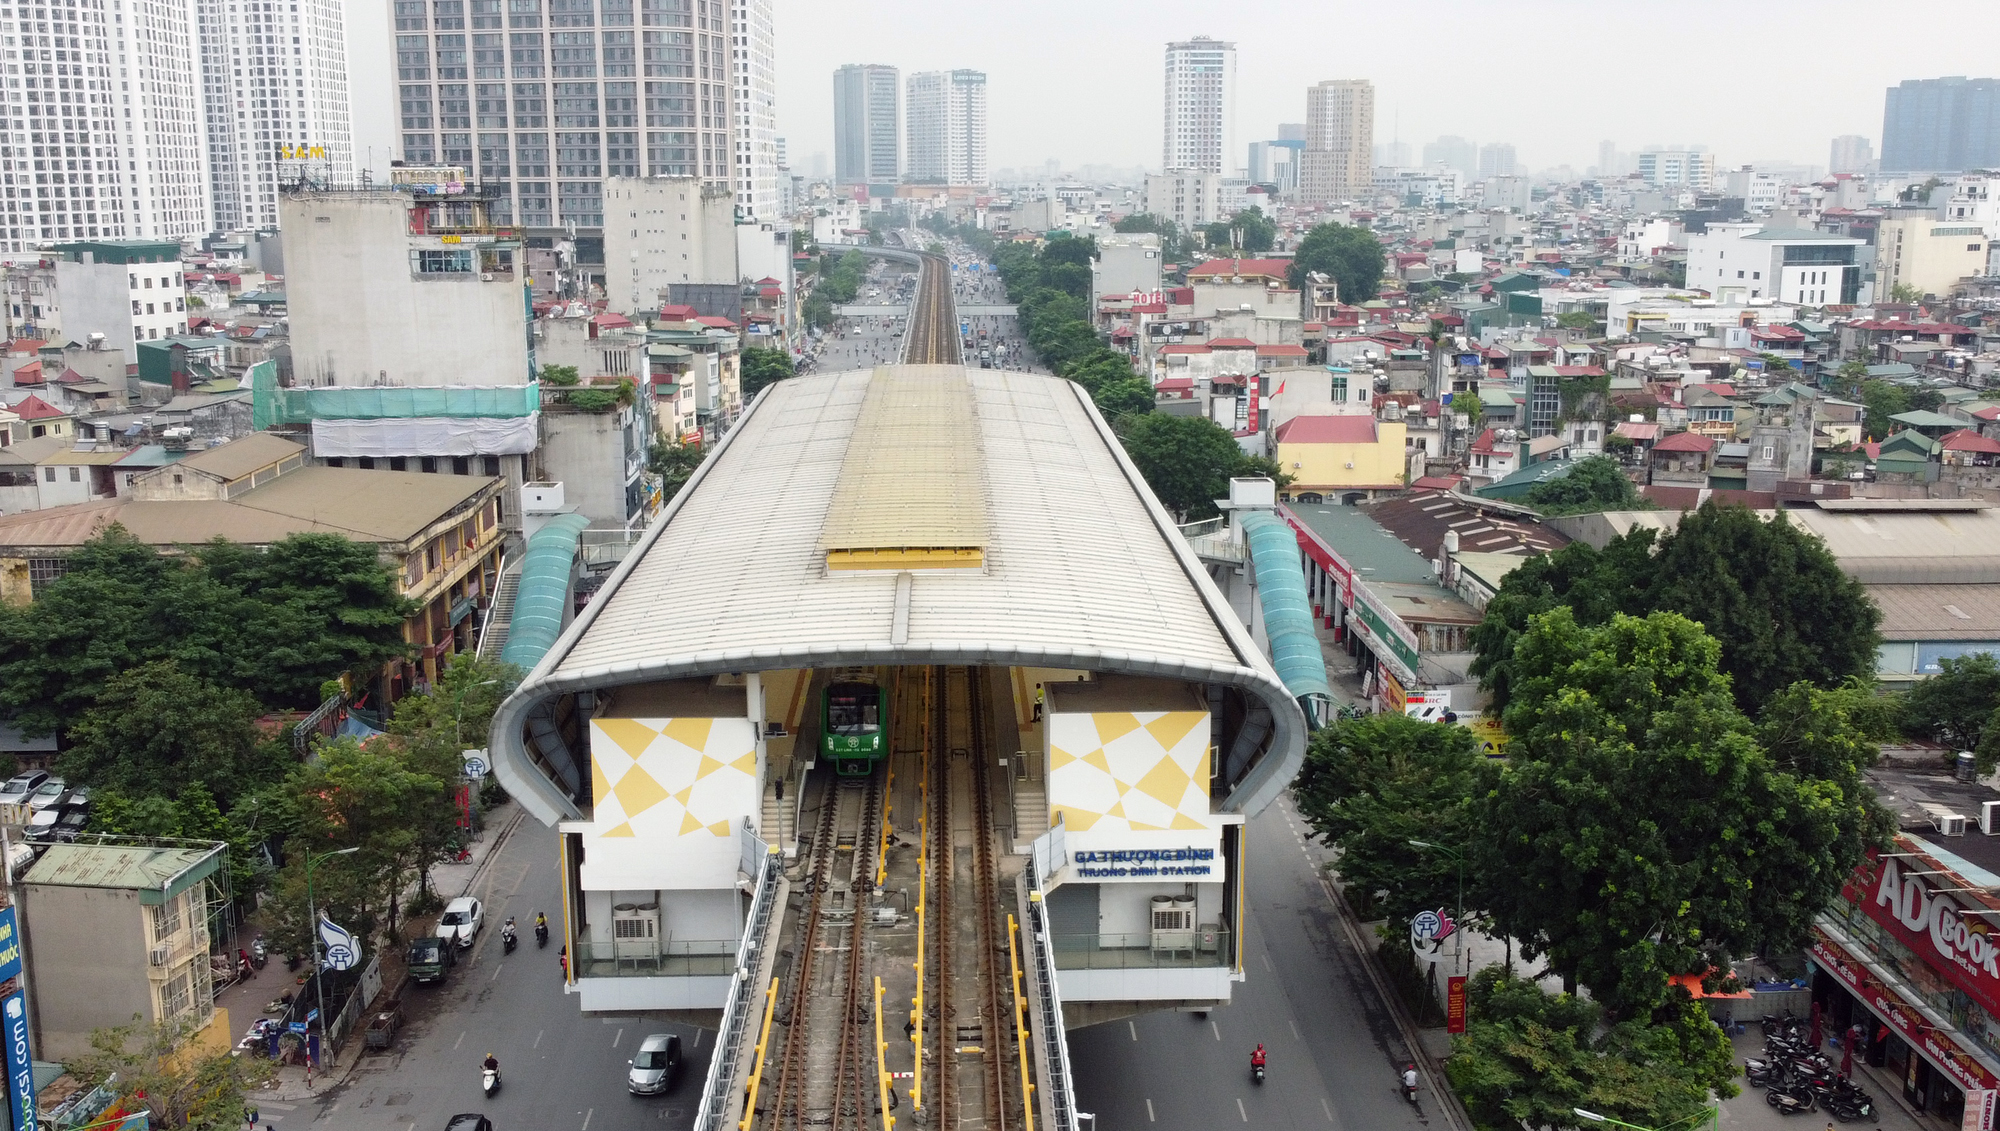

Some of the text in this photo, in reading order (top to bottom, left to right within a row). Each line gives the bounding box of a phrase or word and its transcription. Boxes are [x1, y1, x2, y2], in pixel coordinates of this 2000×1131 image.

[281, 146, 325, 159] SAM
[441, 235, 461, 244] SAM
[1133, 293, 1167, 304] HOTEL
[1075, 851, 1097, 863] GA
[1077, 867, 1127, 877] THUONG
[1161, 865, 1211, 876] STATION
[1983, 1091, 1993, 1130] HONDA
